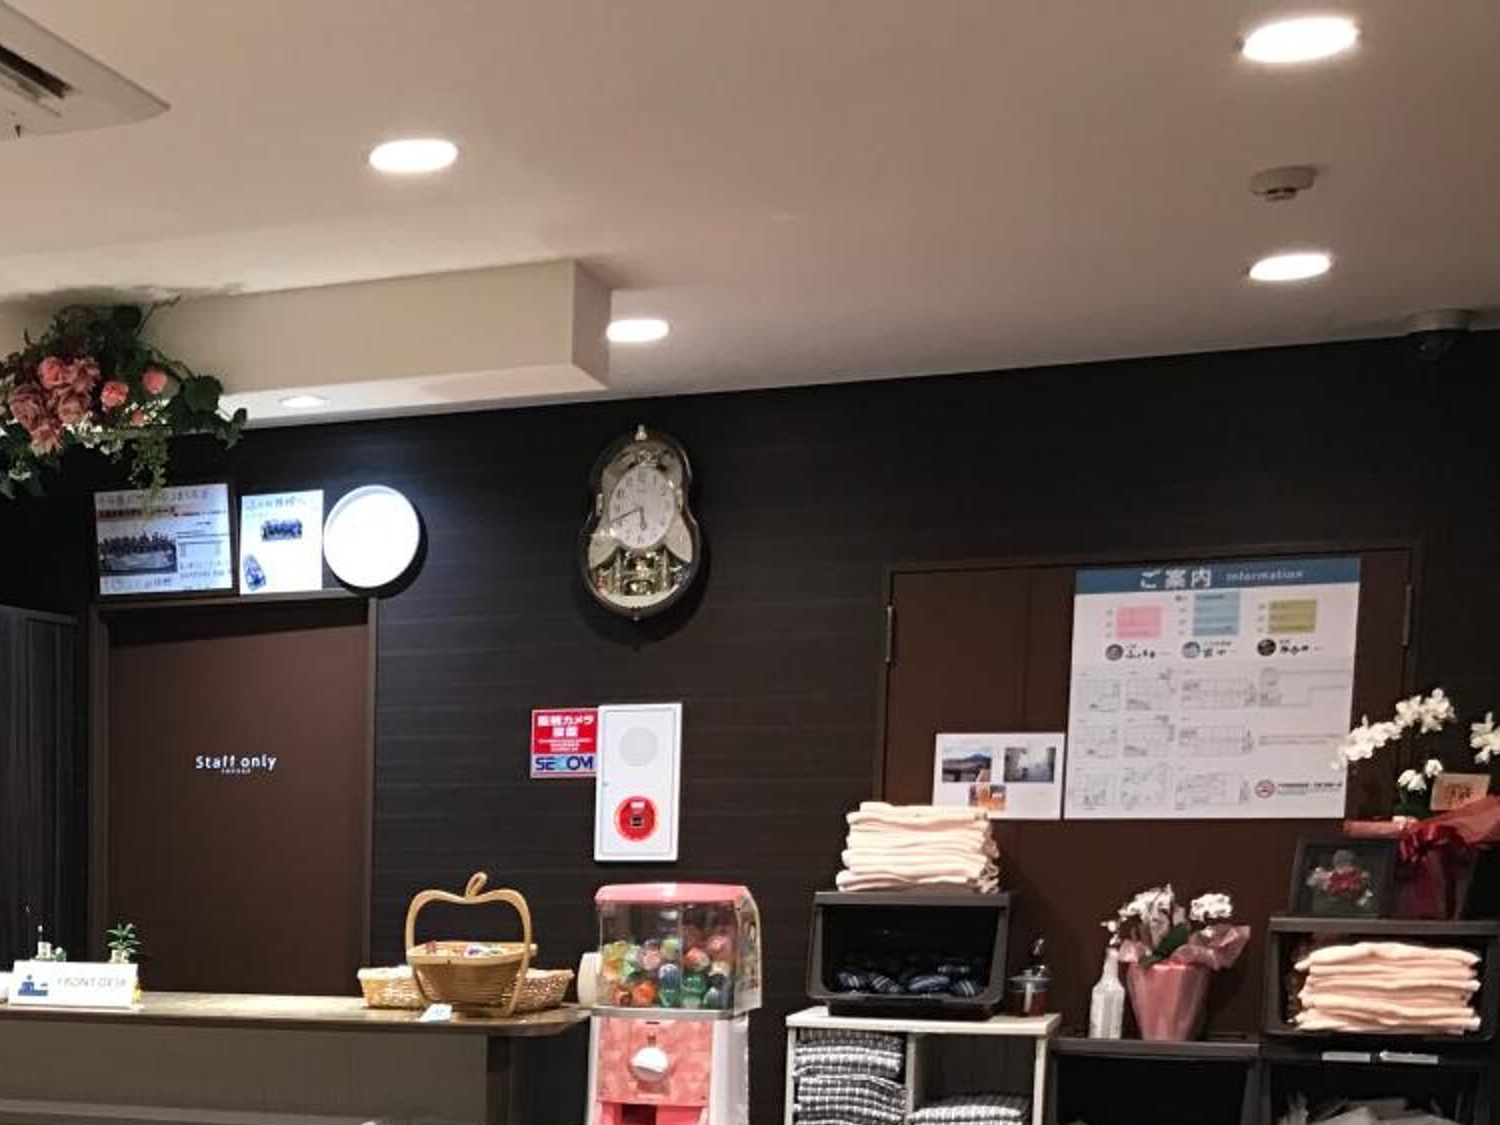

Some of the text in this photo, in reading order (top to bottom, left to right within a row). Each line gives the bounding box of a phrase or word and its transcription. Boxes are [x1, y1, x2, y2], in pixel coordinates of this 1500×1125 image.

[1140, 566, 1213, 589] ご案内
[195, 753, 277, 772] Staff only
[535, 755, 594, 771] SECOM
